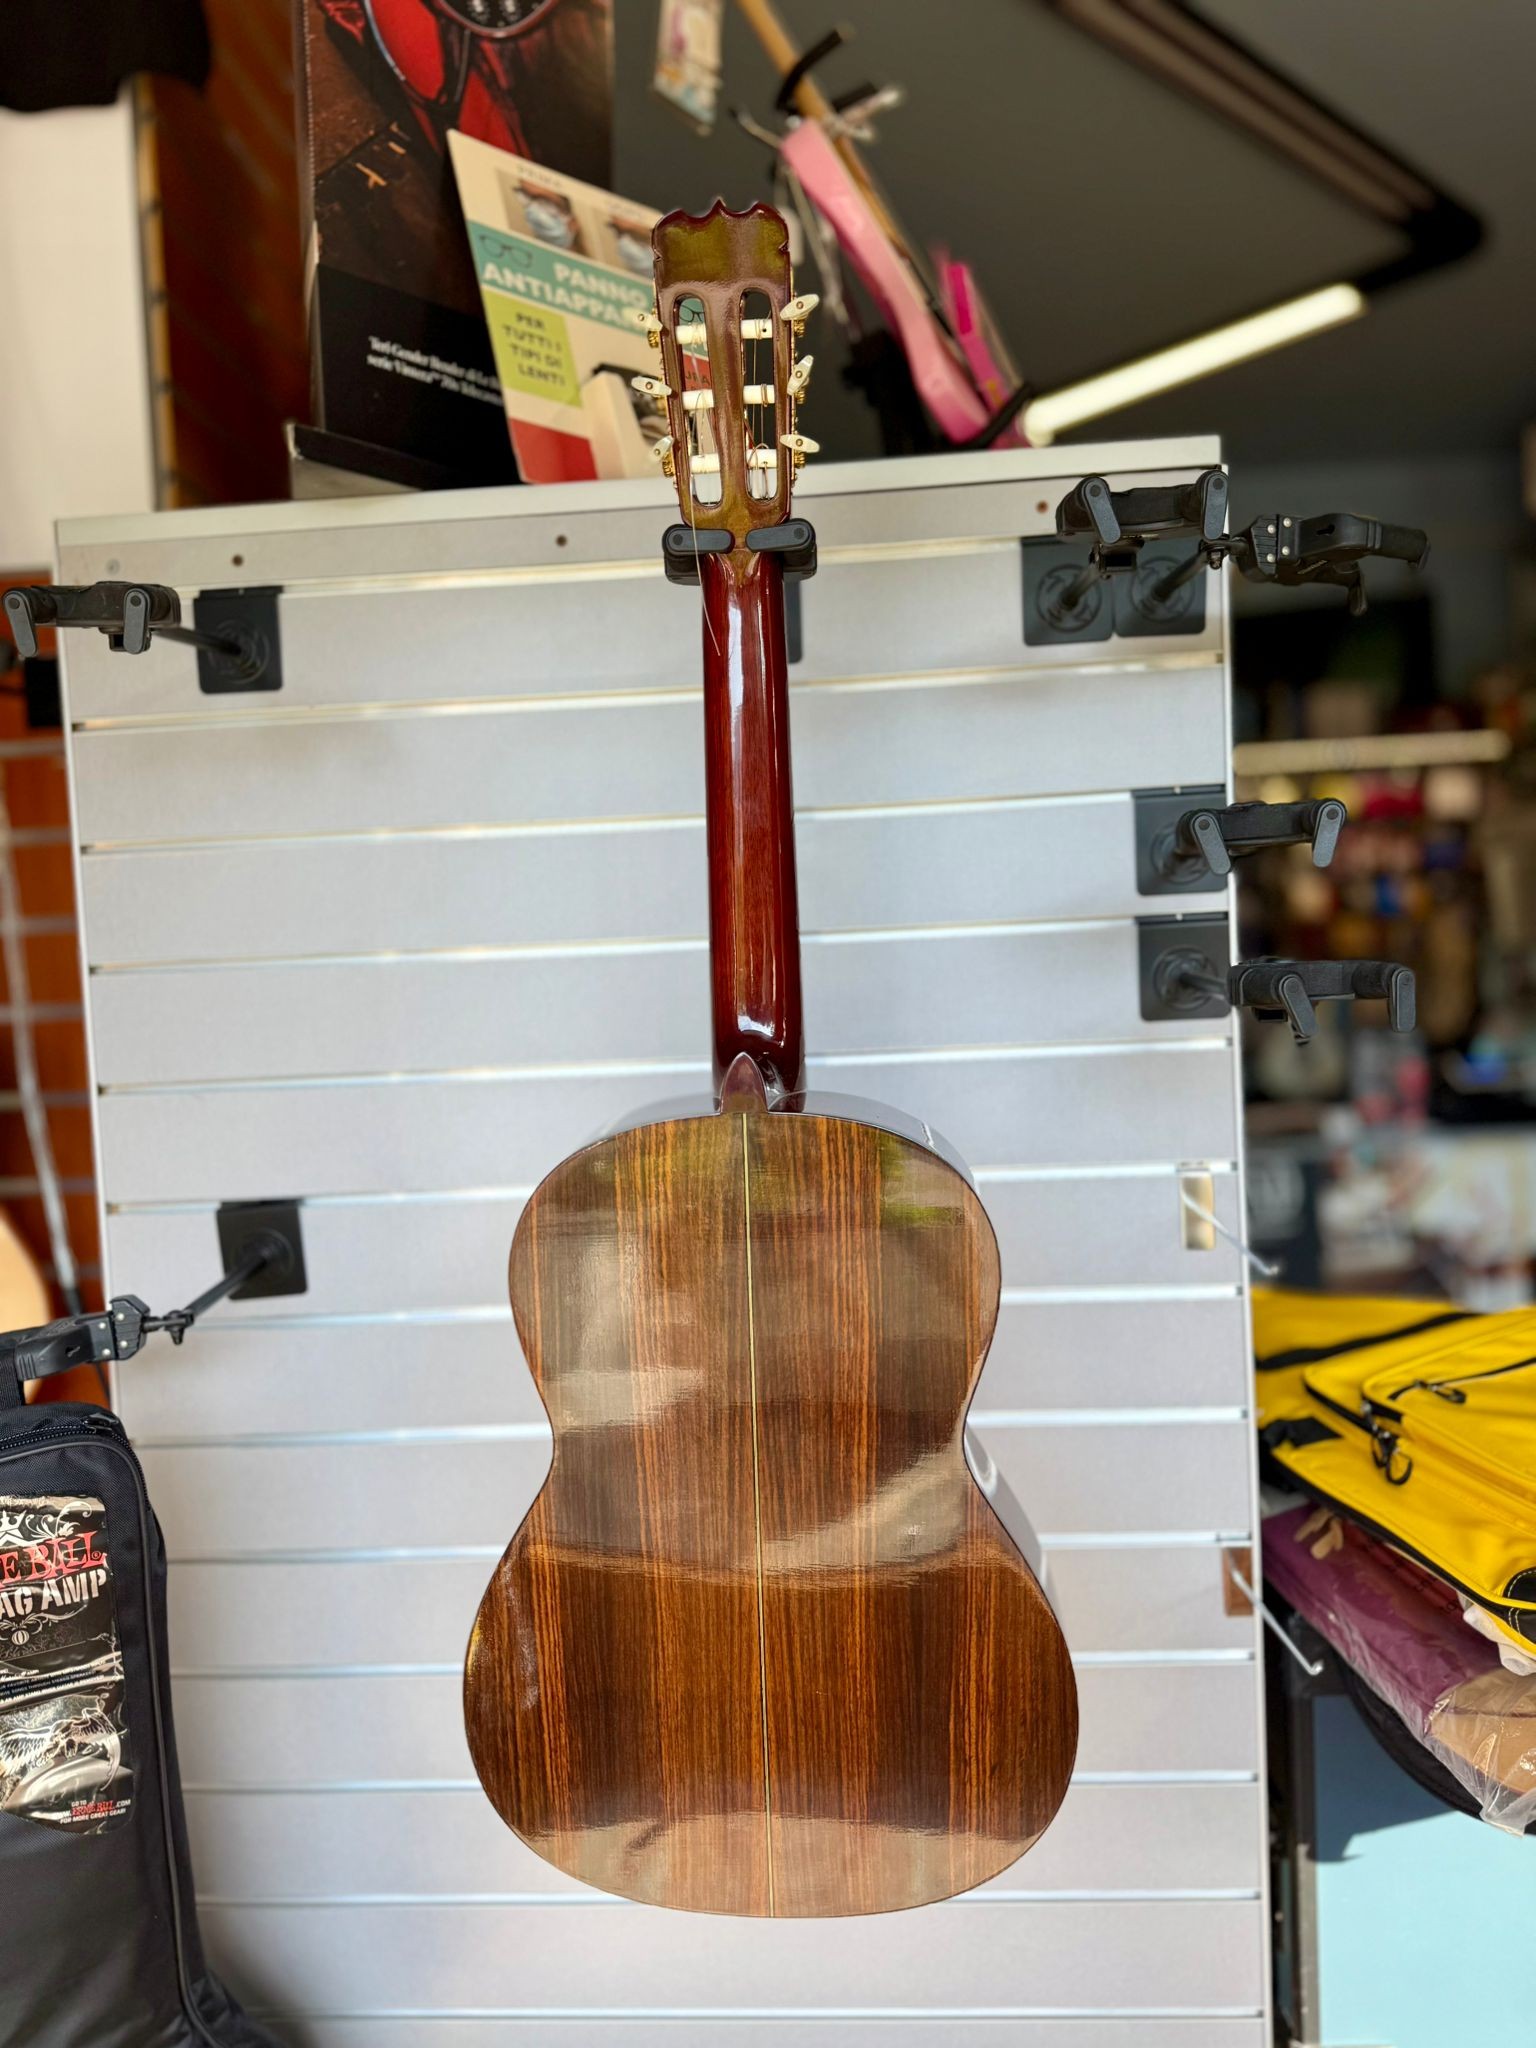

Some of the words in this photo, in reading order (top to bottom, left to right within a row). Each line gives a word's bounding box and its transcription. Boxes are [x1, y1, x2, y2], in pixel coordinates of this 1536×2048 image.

[483, 262, 648, 328] ANTIAPPA
[553, 262, 650, 309] PANNO
[502, 325, 554, 348] TUTTI
[516, 312, 545, 330] PER
[518, 363, 566, 386] LENTI
[41, 1568, 107, 1610] AMP
